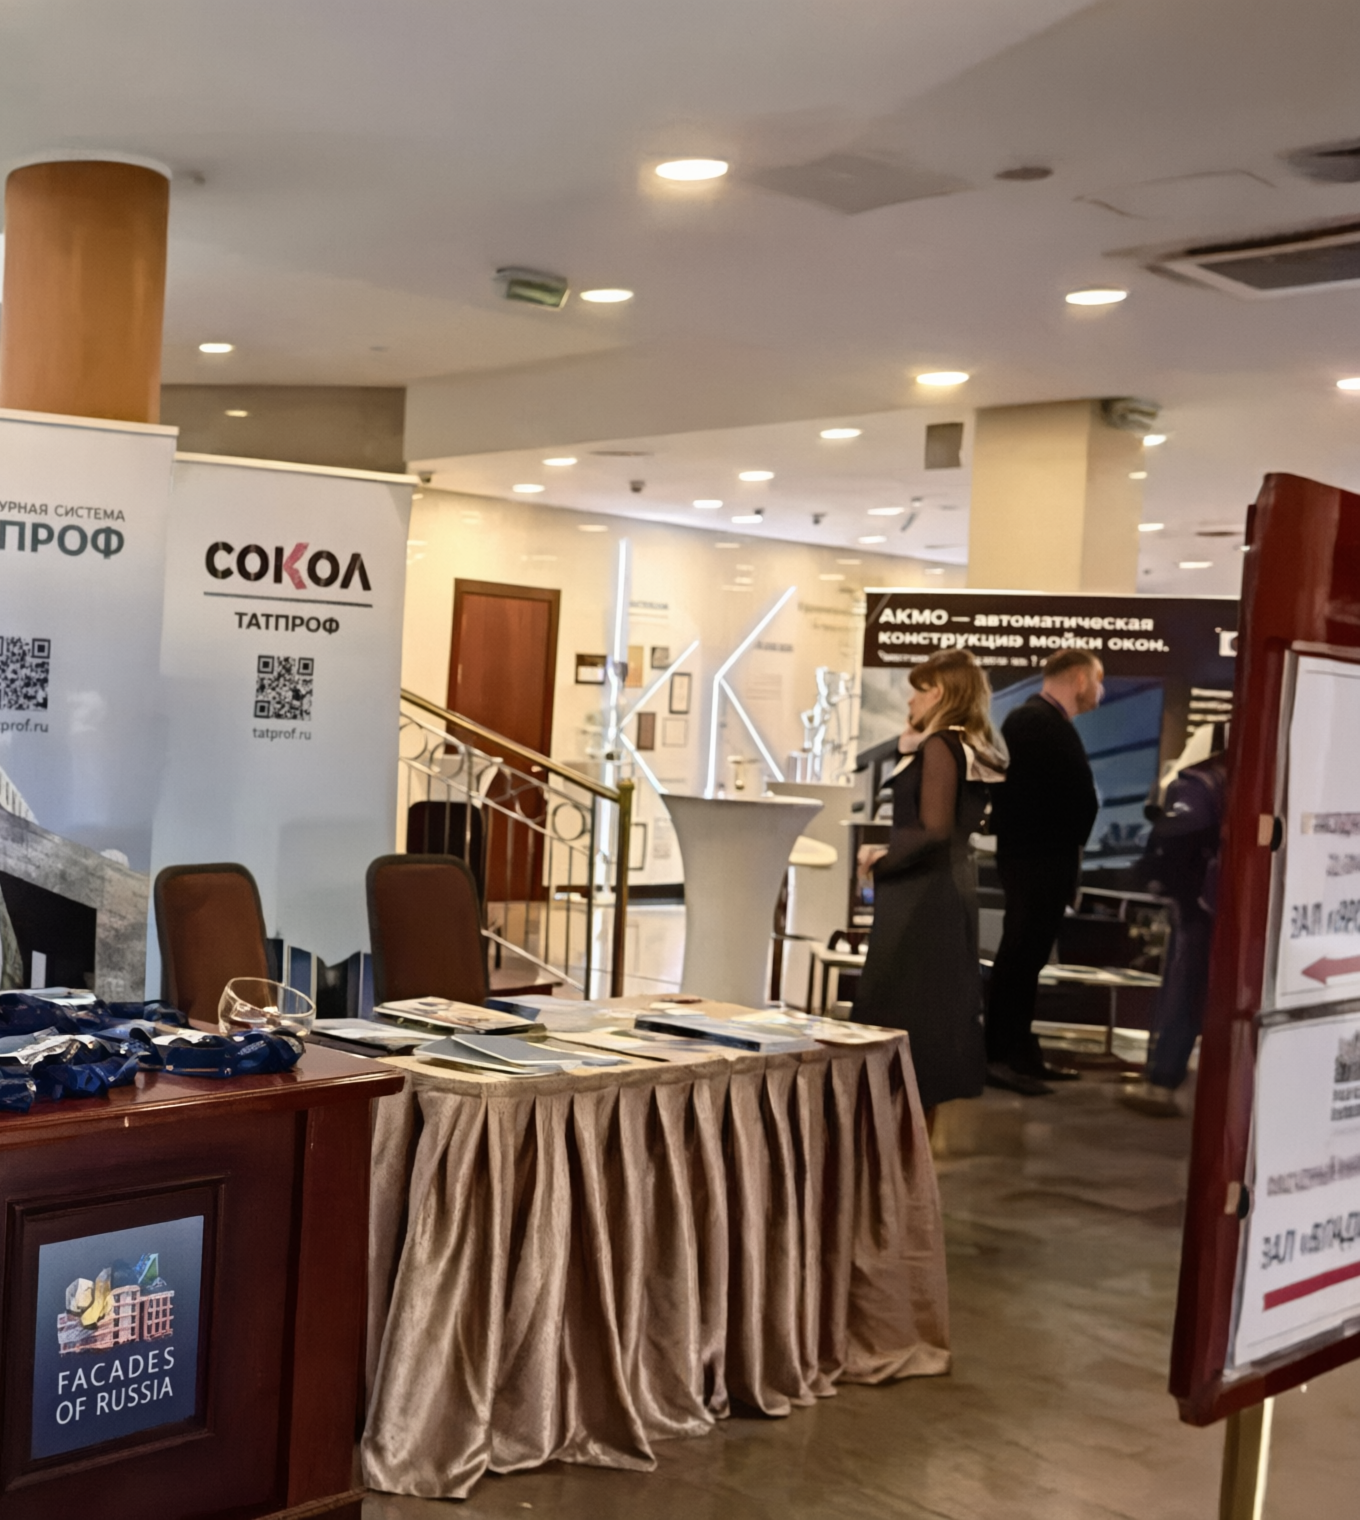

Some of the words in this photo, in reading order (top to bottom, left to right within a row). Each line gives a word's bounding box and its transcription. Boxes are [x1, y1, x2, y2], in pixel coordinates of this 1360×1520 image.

[54, 504, 126, 522] СИСТЕМА
[205, 541, 372, 591] СОКОЛ
[234, 611, 340, 635] ТАТПРОФ
[878, 607, 949, 626] АКМО
[973, 613, 1154, 632] автоматическая
[1029, 631, 1103, 650] мойки
[1107, 638, 1170, 653] окон.
[252, 726, 312, 742] tatprof.ru
[58, 1346, 175, 1395] FACADES
[55, 1396, 87, 1425] OF
[96, 1376, 173, 1416] RUSSIA
